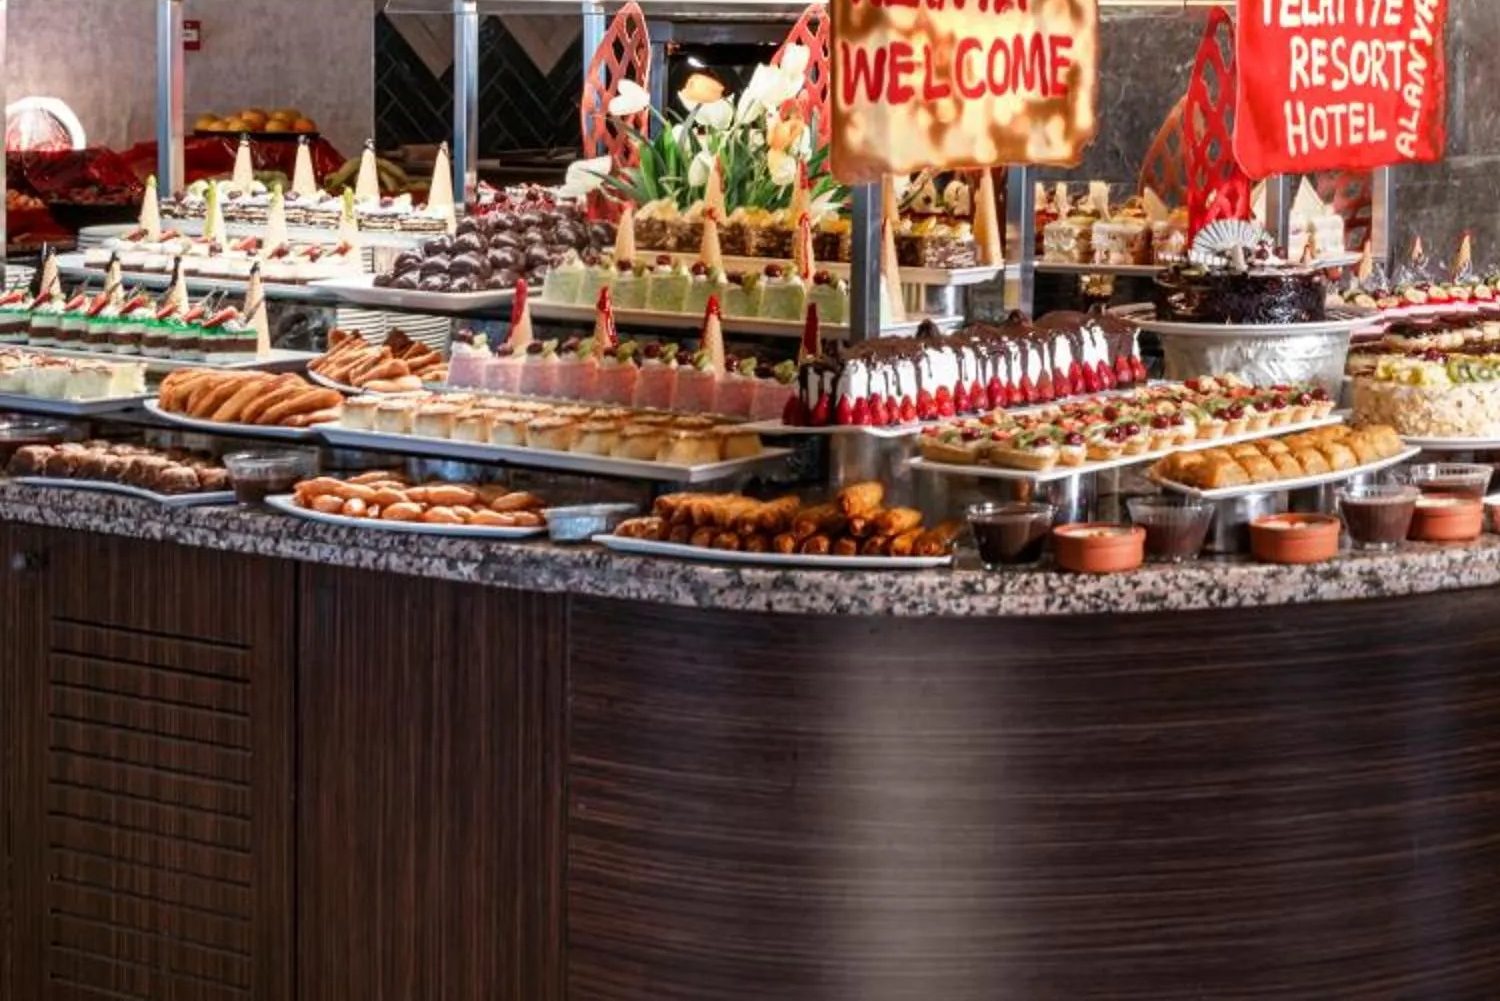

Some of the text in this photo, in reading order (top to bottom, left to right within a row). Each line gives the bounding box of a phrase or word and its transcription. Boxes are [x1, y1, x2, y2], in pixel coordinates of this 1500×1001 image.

[841, 32, 1074, 106] WELCOME
[1289, 35, 1406, 92] RESORT
[1283, 100, 1387, 157] HOTEL
